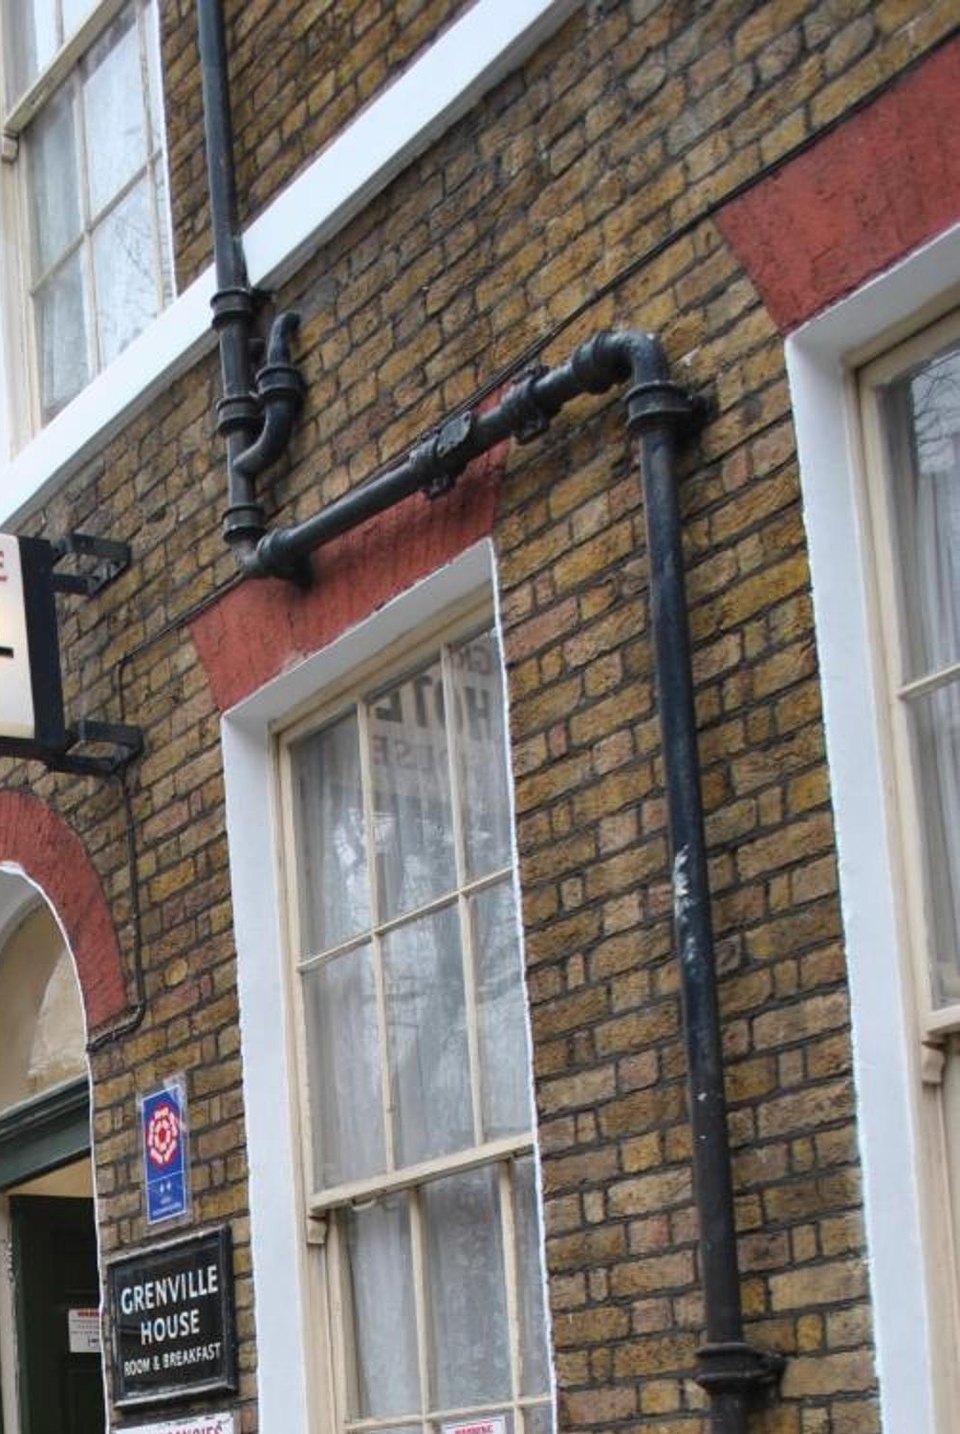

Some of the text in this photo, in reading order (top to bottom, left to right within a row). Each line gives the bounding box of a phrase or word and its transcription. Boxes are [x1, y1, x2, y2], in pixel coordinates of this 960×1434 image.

[120, 1264, 218, 1315] GRENVILLE
[140, 1309, 200, 1346] HOUSE
[124, 1342, 222, 1377] ROOM & BREAKFAST
